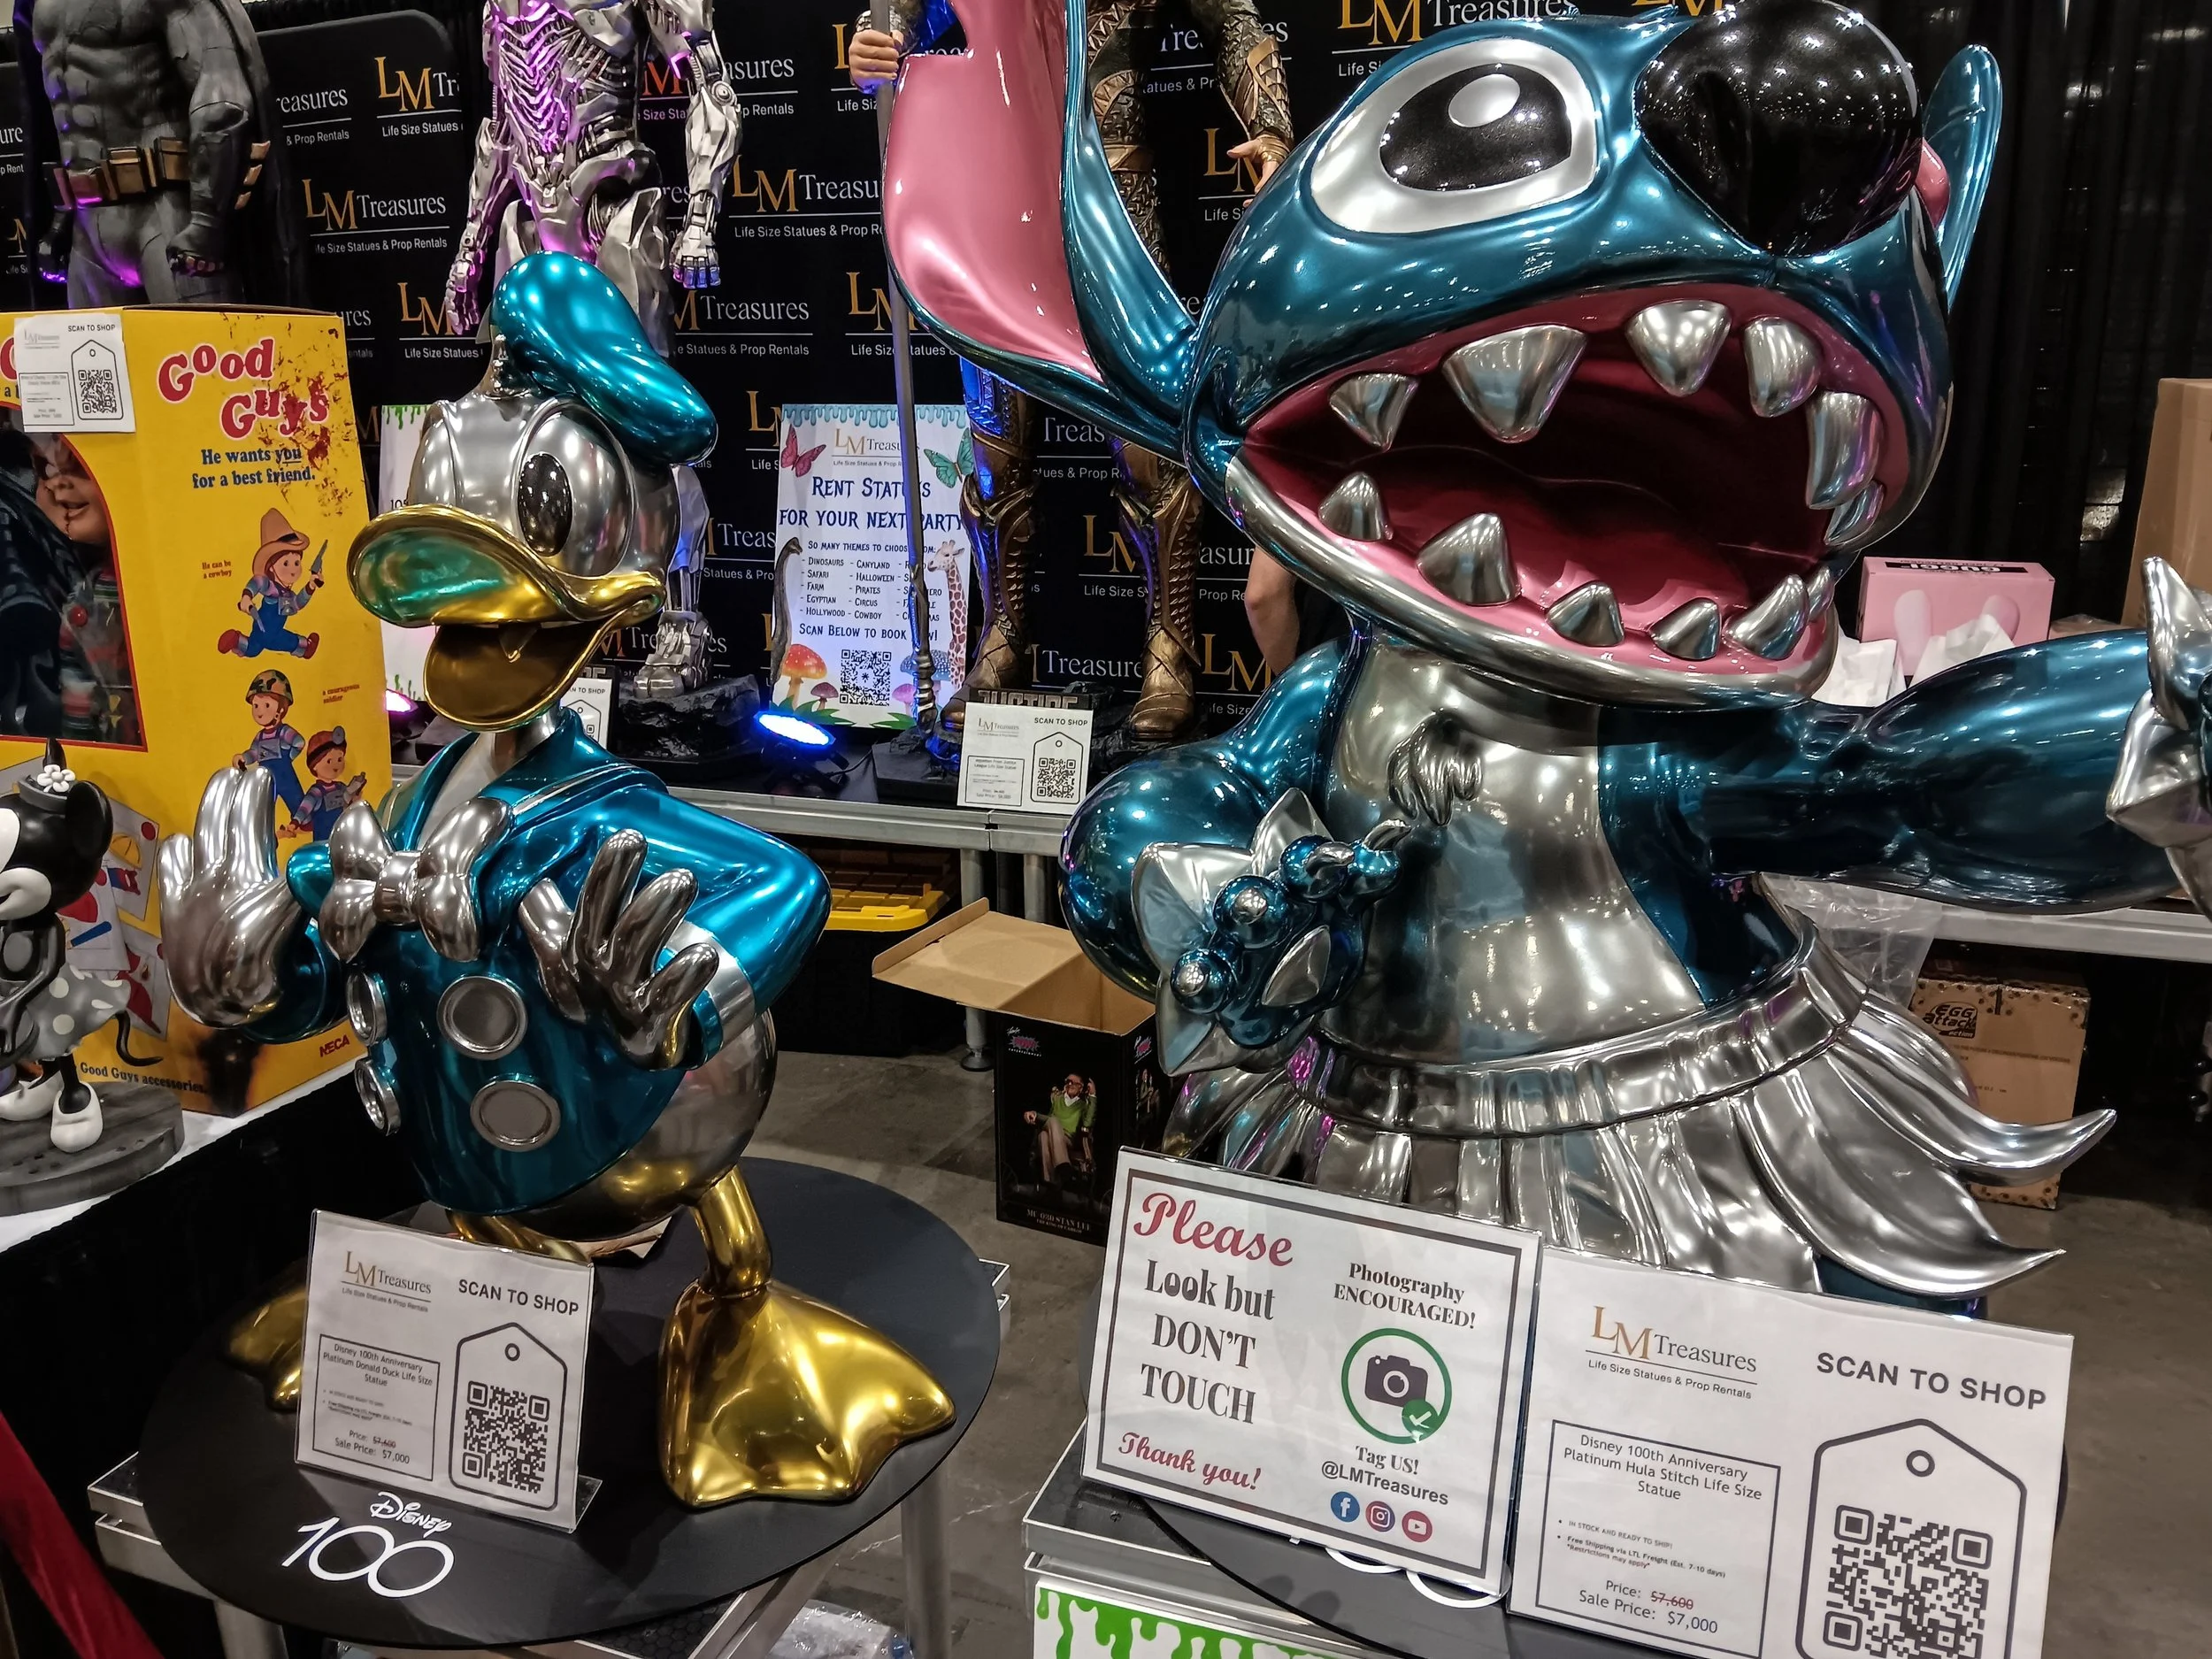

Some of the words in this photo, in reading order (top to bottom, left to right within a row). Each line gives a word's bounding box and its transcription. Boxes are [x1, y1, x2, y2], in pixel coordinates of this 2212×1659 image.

[374, 57, 435, 111] LM
[752, 102, 795, 116] Rentals
[837, 99, 854, 112] Life
[295, 132, 316, 147] Prop
[318, 129, 349, 143] Rentals
[382, 125, 398, 137] Life
[401, 123, 419, 136] Size
[422, 121, 459, 134] Statues
[732, 155, 799, 212] LM
[302, 179, 357, 232] LM
[357, 194, 447, 219] Treasures
[1204, 209, 1229, 221] Life
[734, 226, 755, 239] Life
[757, 225, 780, 238] Size
[784, 224, 826, 238] Statues
[841, 224, 868, 240] Prop
[327, 242, 346, 255] Size
[348, 241, 380, 253] Statues
[391, 239, 412, 253] Prop
[415, 237, 448, 250] Rentals
[701, 295, 810, 321] Treasures
[443, 347, 480, 358] Statues
[686, 342, 726, 355] Statues
[741, 343, 766, 357] Prop
[768, 342, 810, 356] Rentals
[852, 343, 869, 356] Life
[157, 337, 276, 403] Good
[219, 380, 330, 440] Guys
[834, 428, 866, 455] LM
[202, 449, 221, 466] He
[226, 449, 270, 464] wants
[275, 447, 302, 465] you
[752, 459, 771, 471] Life
[192, 472, 216, 488] for
[219, 475, 228, 487] a
[233, 471, 263, 487] best
[266, 467, 316, 484] friend.
[1079, 467, 1108, 480] Prop
[780, 509, 809, 528] FOR
[816, 511, 858, 529] YOUR
[867, 511, 906, 531] NEXT
[842, 542, 870, 551] THEMES
[872, 543, 881, 552] TO
[808, 557, 844, 567] DINOSAURS
[208, 570, 232, 580] cowboy
[703, 567, 742, 580] Statues
[808, 570, 829, 579] SAFARI
[856, 572, 895, 582] HALLOWEEN
[807, 582, 825, 591] FARM
[855, 585, 880, 595] PIRATES
[1084, 584, 1106, 596] Life
[1109, 585, 1133, 598] Size
[1199, 588, 1227, 603] Prop
[806, 595, 836, 604] EGYPTIAN
[855, 598, 878, 607] CIRCUS
[806, 607, 846, 618] HOLLYWOOD
[854, 611, 883, 620] COWBOY
[864, 628, 877, 639] TO
[880, 629, 908, 641] BOOK
[1935, 1004, 1975, 1018] EGG
[319, 1035, 350, 1057] NECA
[81, 1062, 108, 1078] Good
[111, 1067, 140, 1084] Guys
[142, 1075, 207, 1094] accessories.
[1133, 1192, 1294, 1267] Please
[345, 1250, 377, 1286] LM
[378, 1269, 432, 1294] Treasures
[1348, 1262, 1465, 1304] Photography
[458, 1279, 503, 1302] SCAN
[508, 1289, 528, 1306] TO
[534, 1294, 579, 1317] SHOP
[1144, 1259, 1217, 1308] Look
[1225, 1275, 1276, 1320] but
[1333, 1283, 1476, 1329] ENCOURAGED!
[1151, 1313, 1256, 1369] DON'T
[1591, 1306, 1653, 1360] LM
[1654, 1333, 1757, 1372] Treasures
[334, 1343, 357, 1357] Disney
[359, 1350, 380, 1362] 100th
[380, 1356, 423, 1372] Anniversary
[323, 1352, 354, 1366] Platinum
[356, 1361, 380, 1373] Donald
[382, 1366, 399, 1378] Duck
[402, 1371, 416, 1382] Life
[418, 1374, 433, 1386] Size
[365, 1373, 388, 1386] Statue
[1588, 1359, 1607, 1371] Life
[1610, 1363, 1631, 1376] Size
[1633, 1368, 1672, 1384] Statues
[1675, 1377, 1682, 1386] &
[1686, 1378, 1710, 1392] Prop
[1713, 1384, 1752, 1400] Rentals
[1816, 1352, 1899, 1386] SCAN
[1910, 1369, 1949, 1394] TO
[1960, 1378, 2046, 1409] SHOP
[1141, 1363, 1256, 1425] TOUCH
[349, 1430, 368, 1441] Price:
[335, 1437, 351, 1450] Sale
[354, 1442, 377, 1455] Price:
[382, 1449, 410, 1464] $7,000
[1118, 1431, 1196, 1474] Thank
[1202, 1458, 1262, 1490] you!
[1355, 1445, 1387, 1470] Tag
[1390, 1453, 1419, 1475] US!
[1580, 1434, 1623, 1455] Disney
[1628, 1445, 1664, 1463] 100th
[1668, 1454, 1748, 1482] Anniversary
[1321, 1460, 1449, 1506] @LMTreasures
[1564, 1448, 1622, 1471] Platinum
[1626, 1462, 1656, 1478] Hula
[1660, 1469, 1700, 1487] Stitch
[1704, 1477, 1730, 1494] Life
[1734, 1484, 1763, 1501] Size
[1638, 1480, 1681, 1500] Statue
[370, 1491, 453, 1538] Disney
[1578, 1523, 1600, 1532] STOCK
[1601, 1528, 1617, 1537] AND
[1617, 1531, 1641, 1542] READY
[280, 1516, 455, 1599] 100
[1567, 1536, 1584, 1545] Free
[1585, 1540, 1615, 1553] Shipping
[1628, 1550, 1640, 1559] LTL
[1643, 1553, 1668, 1565] Freight
[1688, 1563, 1705, 1573] 7-10
[1707, 1567, 1726, 1578] days)
[1612, 1555, 1626, 1564] may
[1606, 1579, 1641, 1599] Price:
[1651, 1591, 1694, 1609] $7,600
[1579, 1589, 1609, 1609] Sale
[1615, 1597, 1655, 1620] Price:
[1668, 1611, 1718, 1634] $7,000
